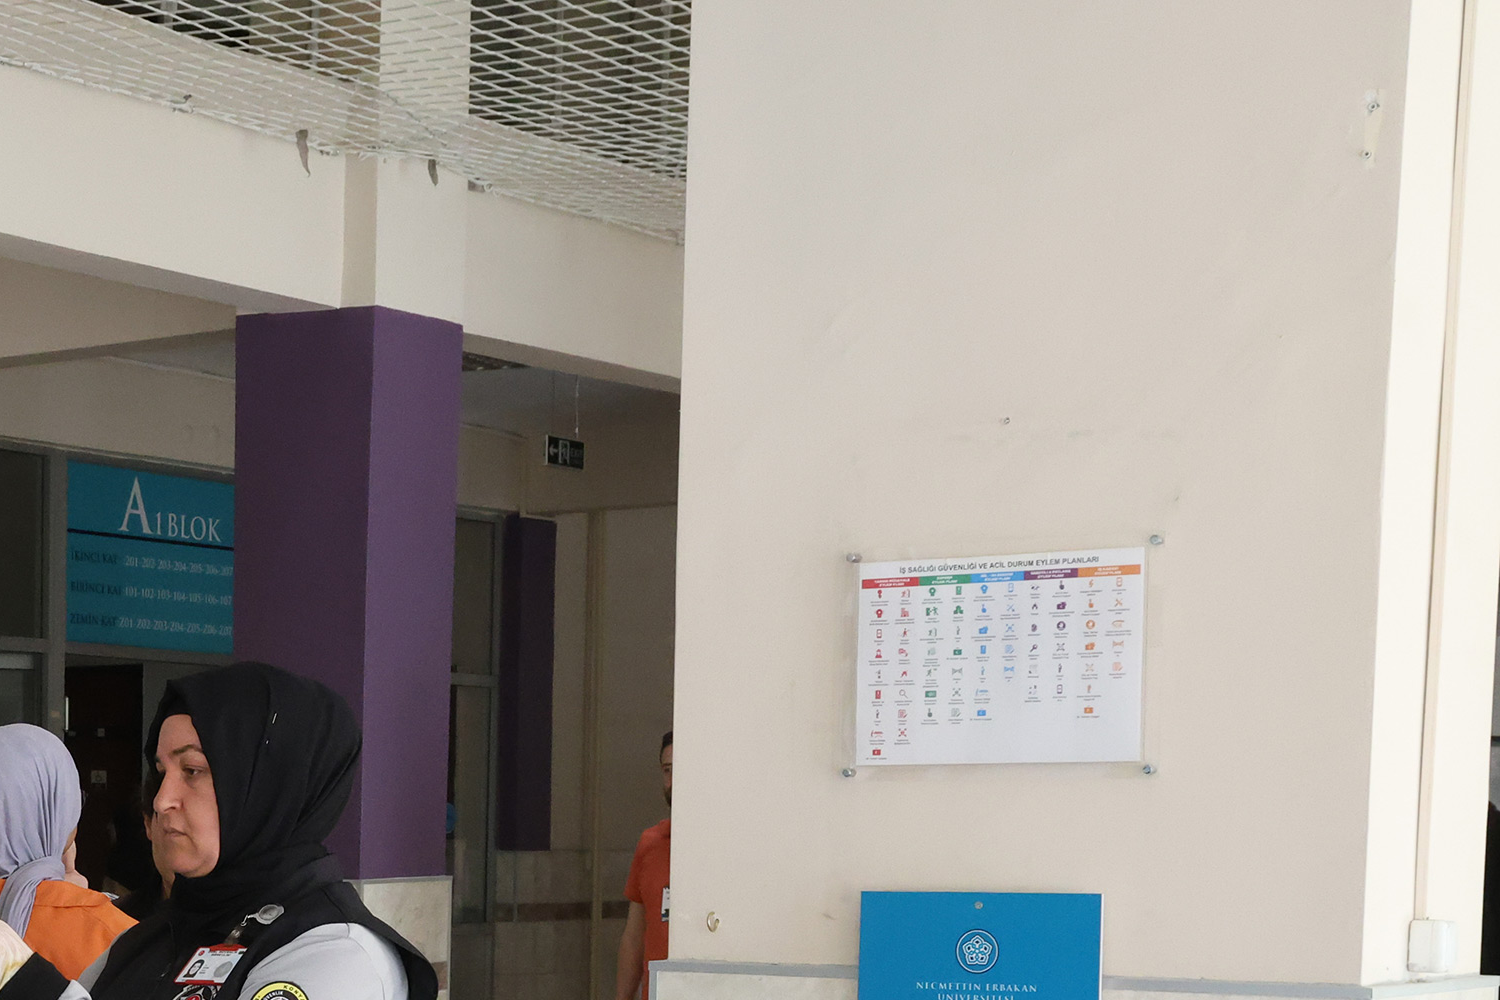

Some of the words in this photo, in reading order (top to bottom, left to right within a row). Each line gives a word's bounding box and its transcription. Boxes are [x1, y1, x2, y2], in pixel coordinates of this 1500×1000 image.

[938, 561, 978, 572] GÜVENLİĞİ
[978, 562, 988, 570] VE
[990, 560, 1006, 569] ACİL
[1008, 559, 1034, 568] DURUM
[1036, 558, 1061, 567] EYLEM
[1062, 555, 1100, 565] PLANLARI
[986, 983, 1038, 993] ERBAKAN
